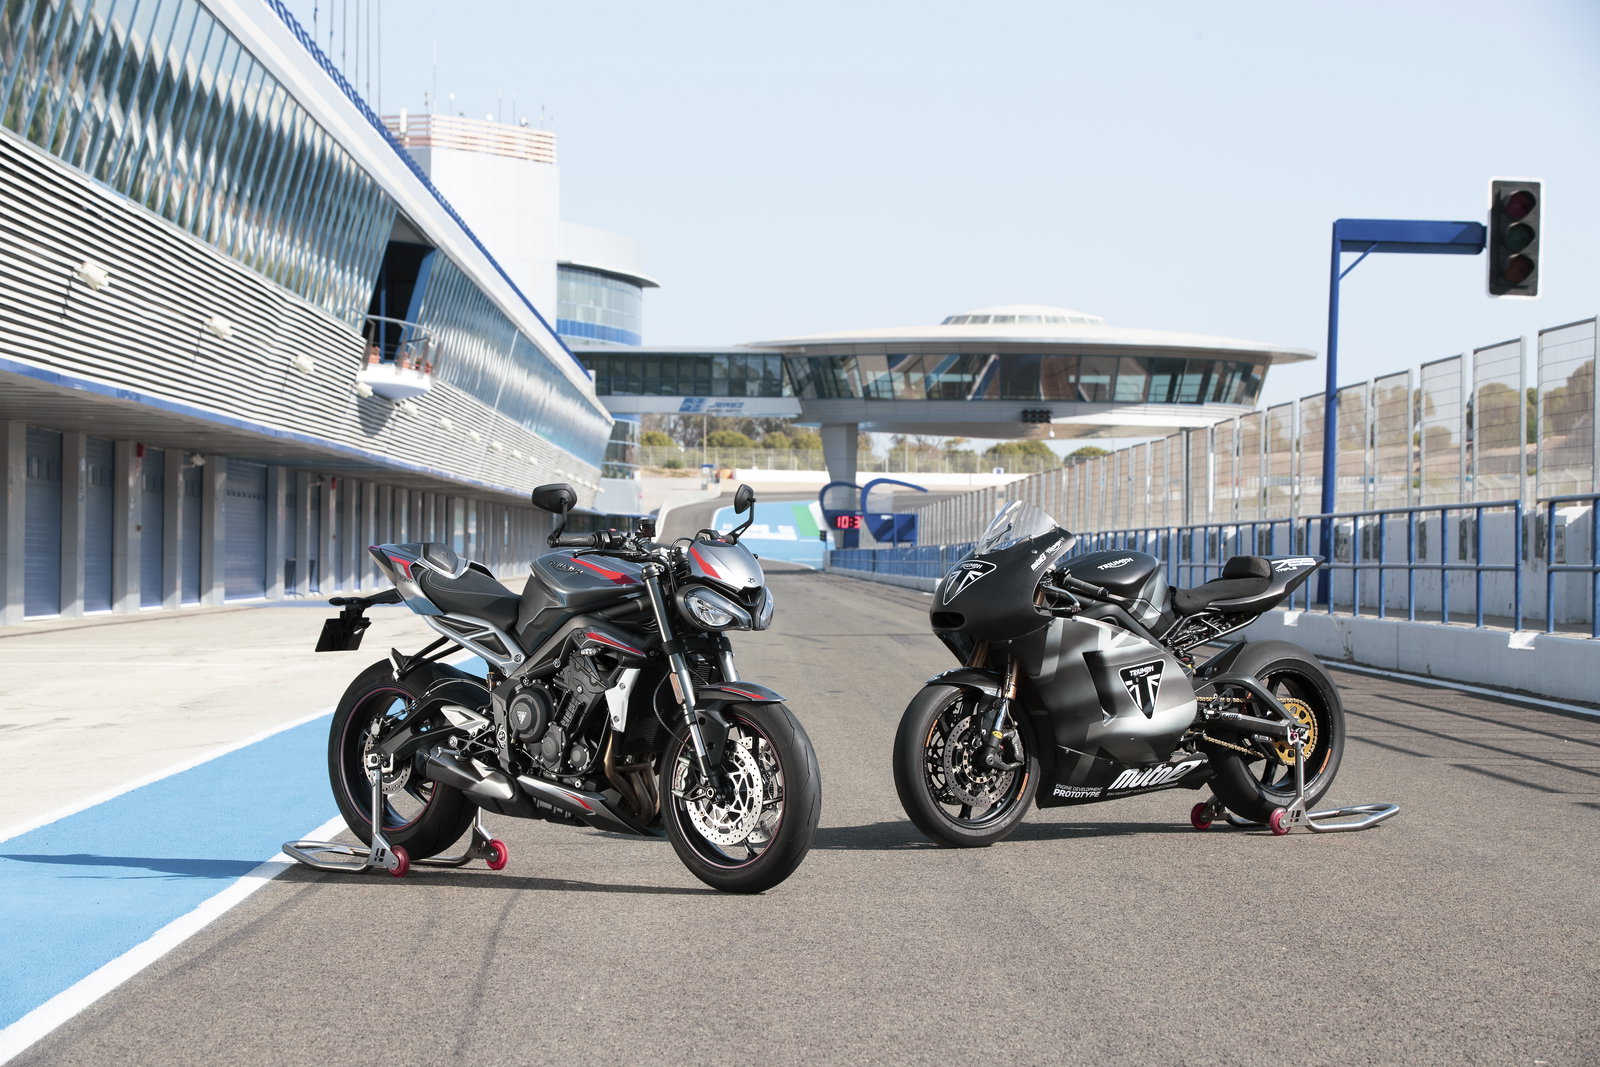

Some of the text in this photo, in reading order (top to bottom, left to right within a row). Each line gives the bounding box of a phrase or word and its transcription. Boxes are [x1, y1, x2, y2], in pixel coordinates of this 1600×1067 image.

[836, 515, 864, 529] 10:3
[1097, 557, 1134, 571] TRIUMPH
[1271, 558, 1316, 569] 765
[1129, 665, 1154, 677] TRIUMPH
[1055, 783, 1073, 792] ENGINE
[1053, 788, 1101, 799] PROTOTYPE
